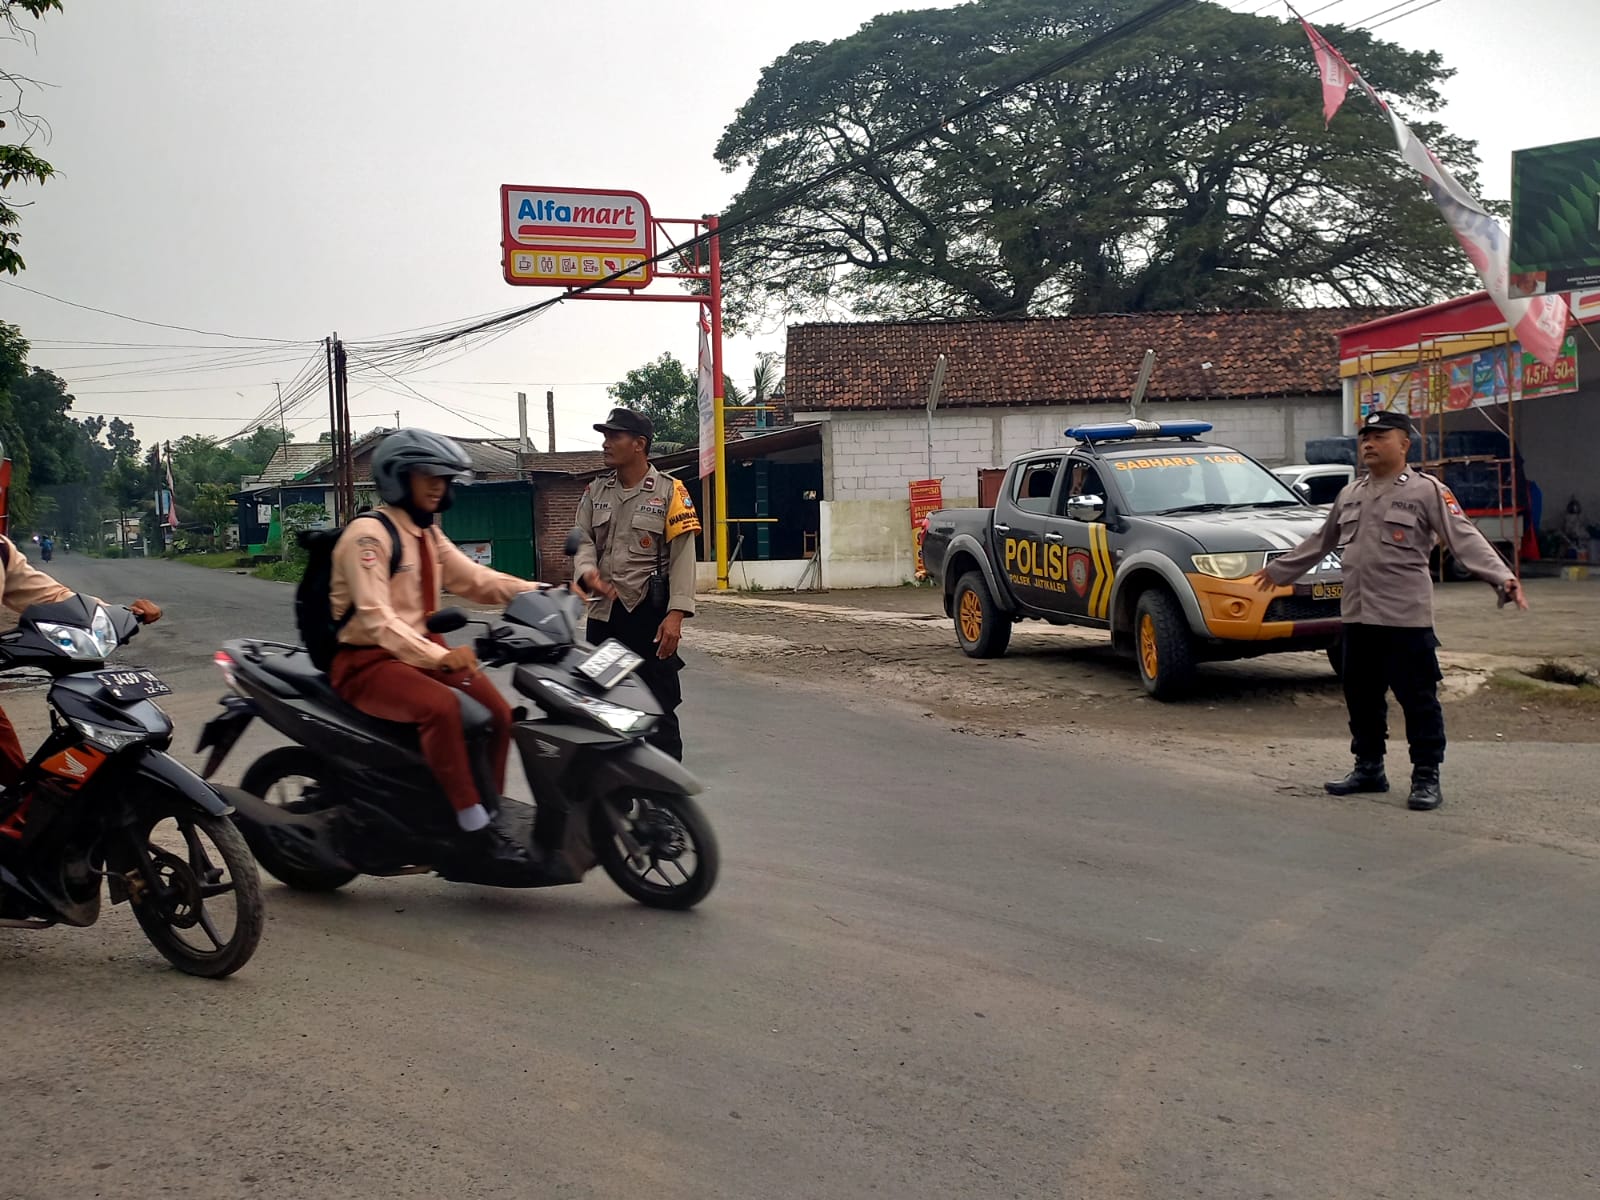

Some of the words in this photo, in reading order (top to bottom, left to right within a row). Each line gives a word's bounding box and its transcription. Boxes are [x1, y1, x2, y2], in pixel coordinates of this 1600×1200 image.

[518, 199, 636, 226] Alfamart
[1114, 456, 1199, 471] SABHARA
[1392, 501, 1417, 512] POLRI
[1005, 538, 1068, 581] POLISI
[1009, 573, 1031, 586] POLSEK
